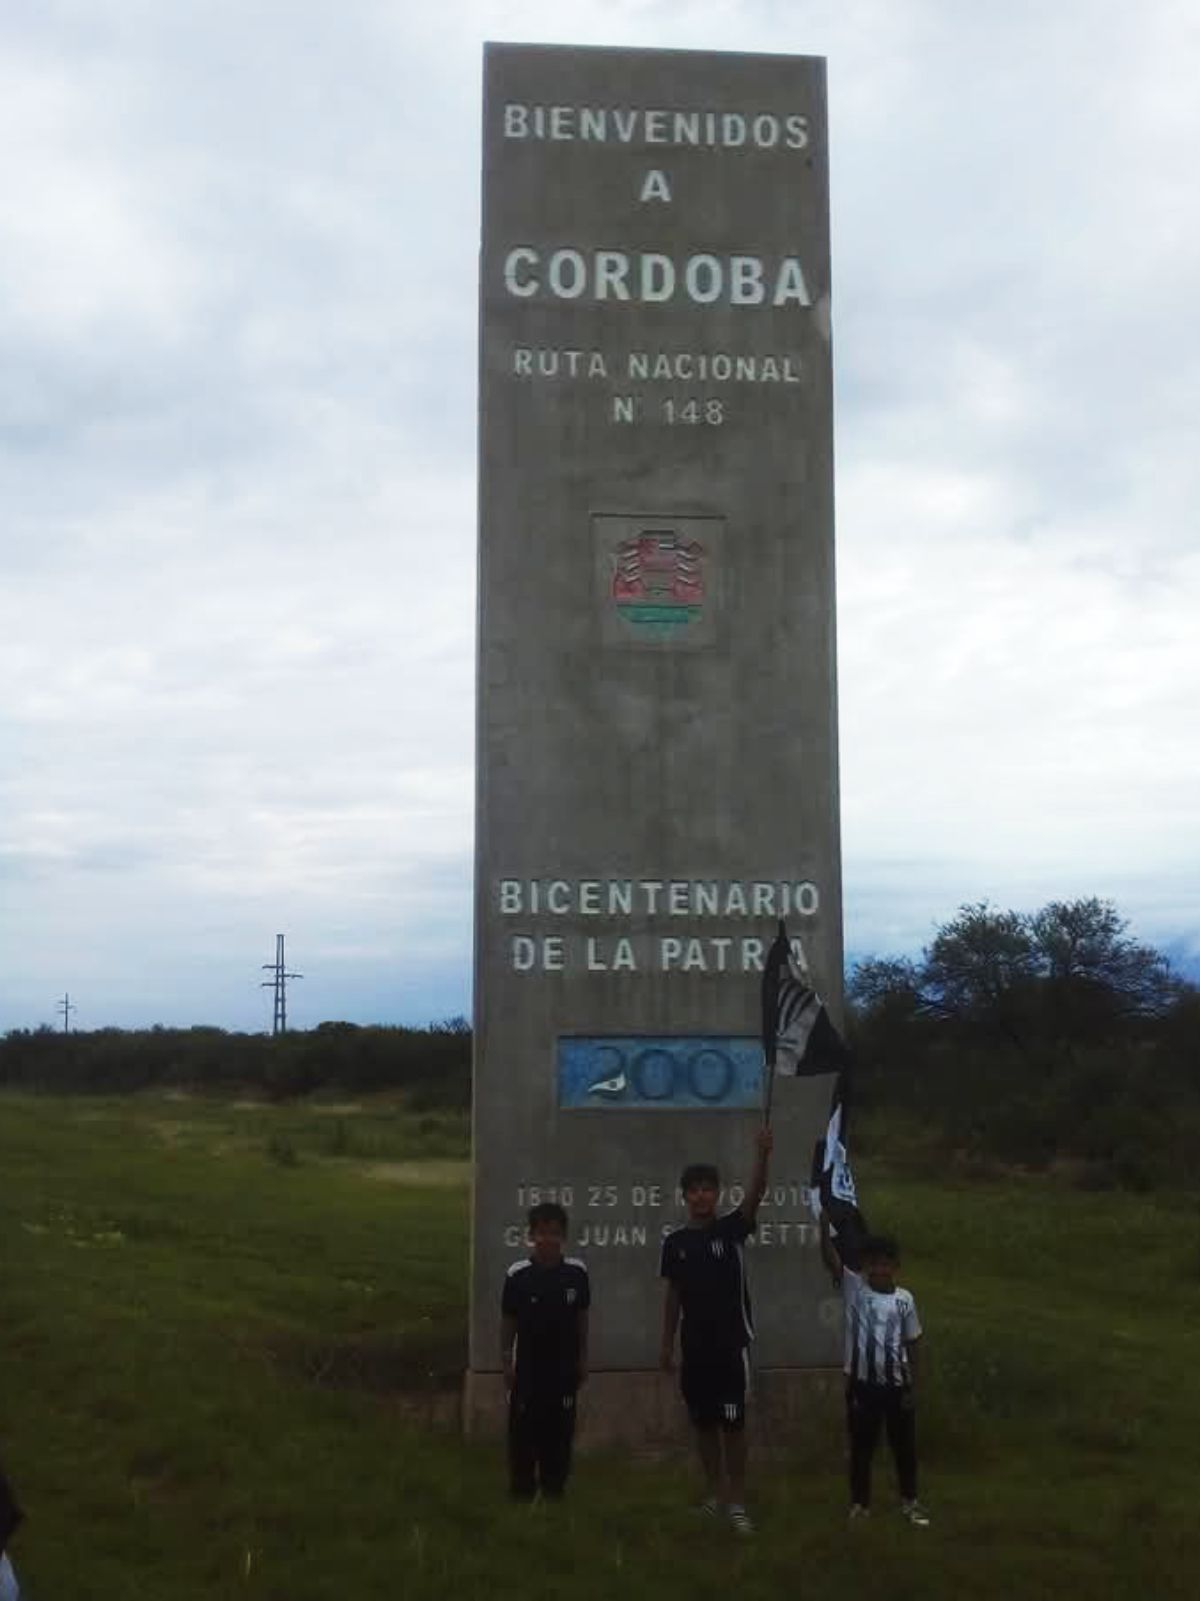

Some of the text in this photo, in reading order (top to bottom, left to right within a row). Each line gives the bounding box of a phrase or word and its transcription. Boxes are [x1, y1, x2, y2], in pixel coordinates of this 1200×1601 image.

[504, 105, 809, 149] BIENVENIDOS
[640, 169, 671, 202] A
[504, 247, 811, 307] CORDOBA
[514, 348, 800, 383] RUTA NACIONAL
[662, 400, 723, 426] 148
[500, 880, 820, 917] BICENTENARIO
[512, 936, 808, 972] DE LA PATRA
[588, 1186, 618, 1207] 25
[632, 1186, 661, 1207] DE
[577, 1226, 647, 1248] JUAN
